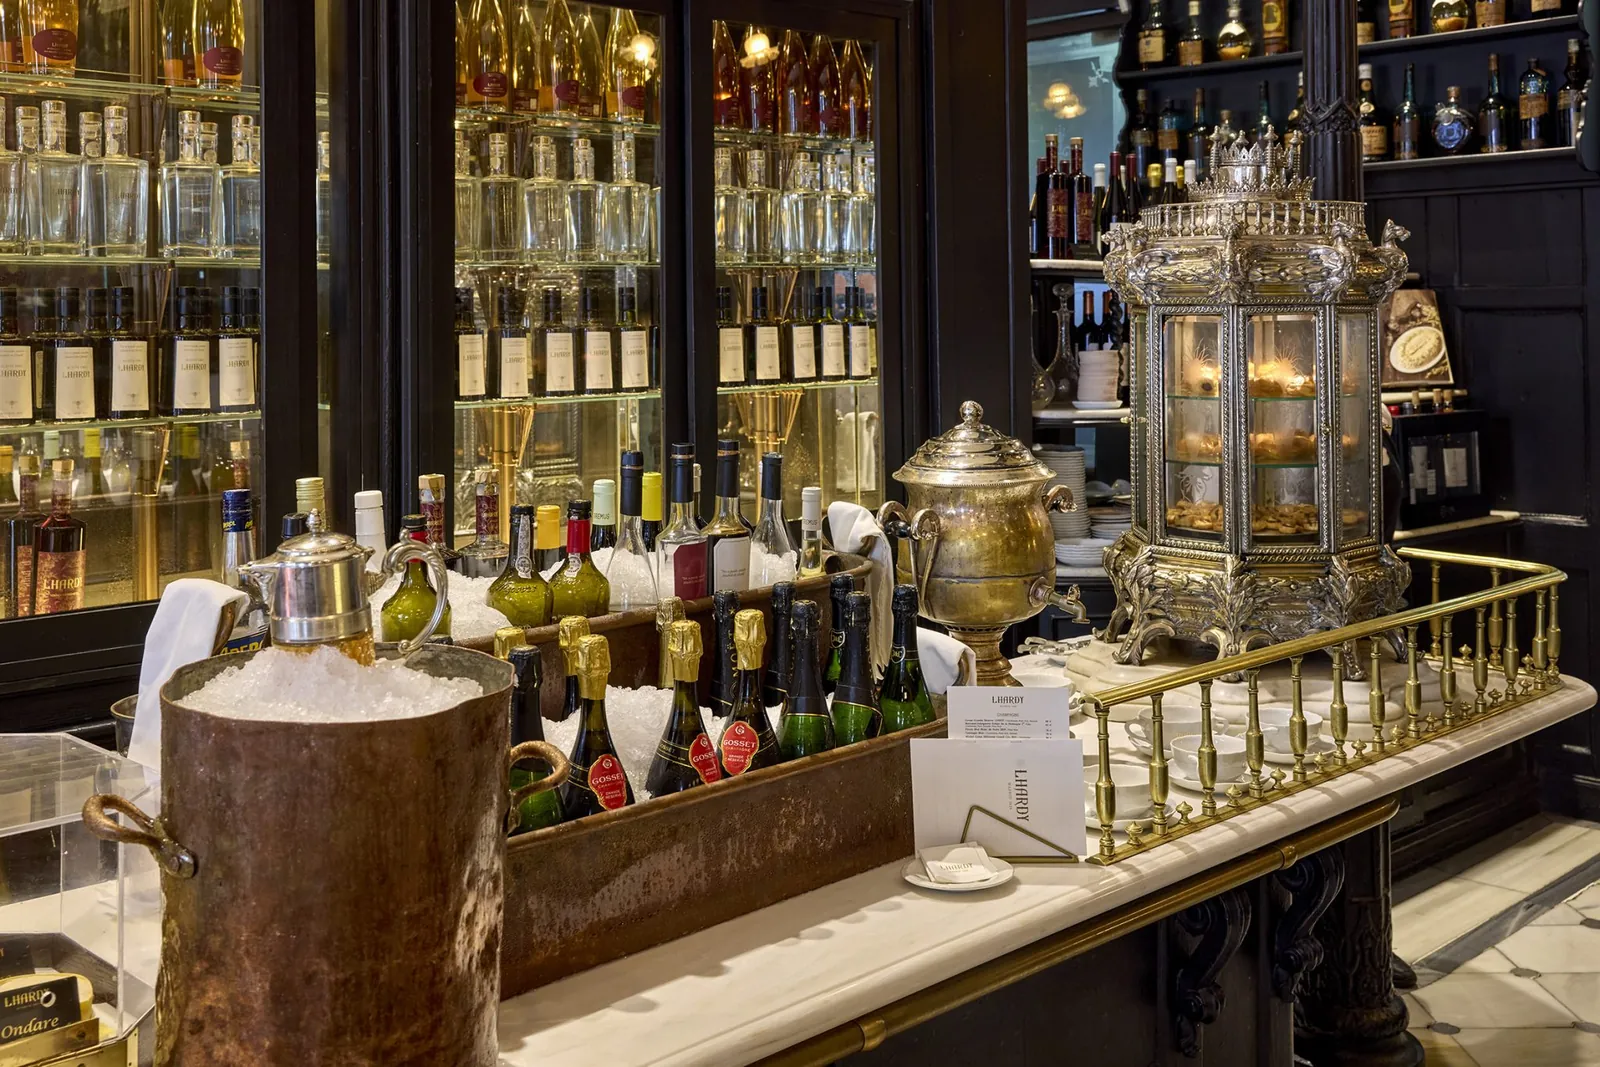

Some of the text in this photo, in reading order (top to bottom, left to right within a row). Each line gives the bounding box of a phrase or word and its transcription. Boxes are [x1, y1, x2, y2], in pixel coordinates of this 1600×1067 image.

[991, 695, 1024, 705] LHARDY
[723, 739, 756, 748] GOSSET
[1014, 769, 1030, 822] LHARDY
[1, 1016, 59, 1039] Ondare
